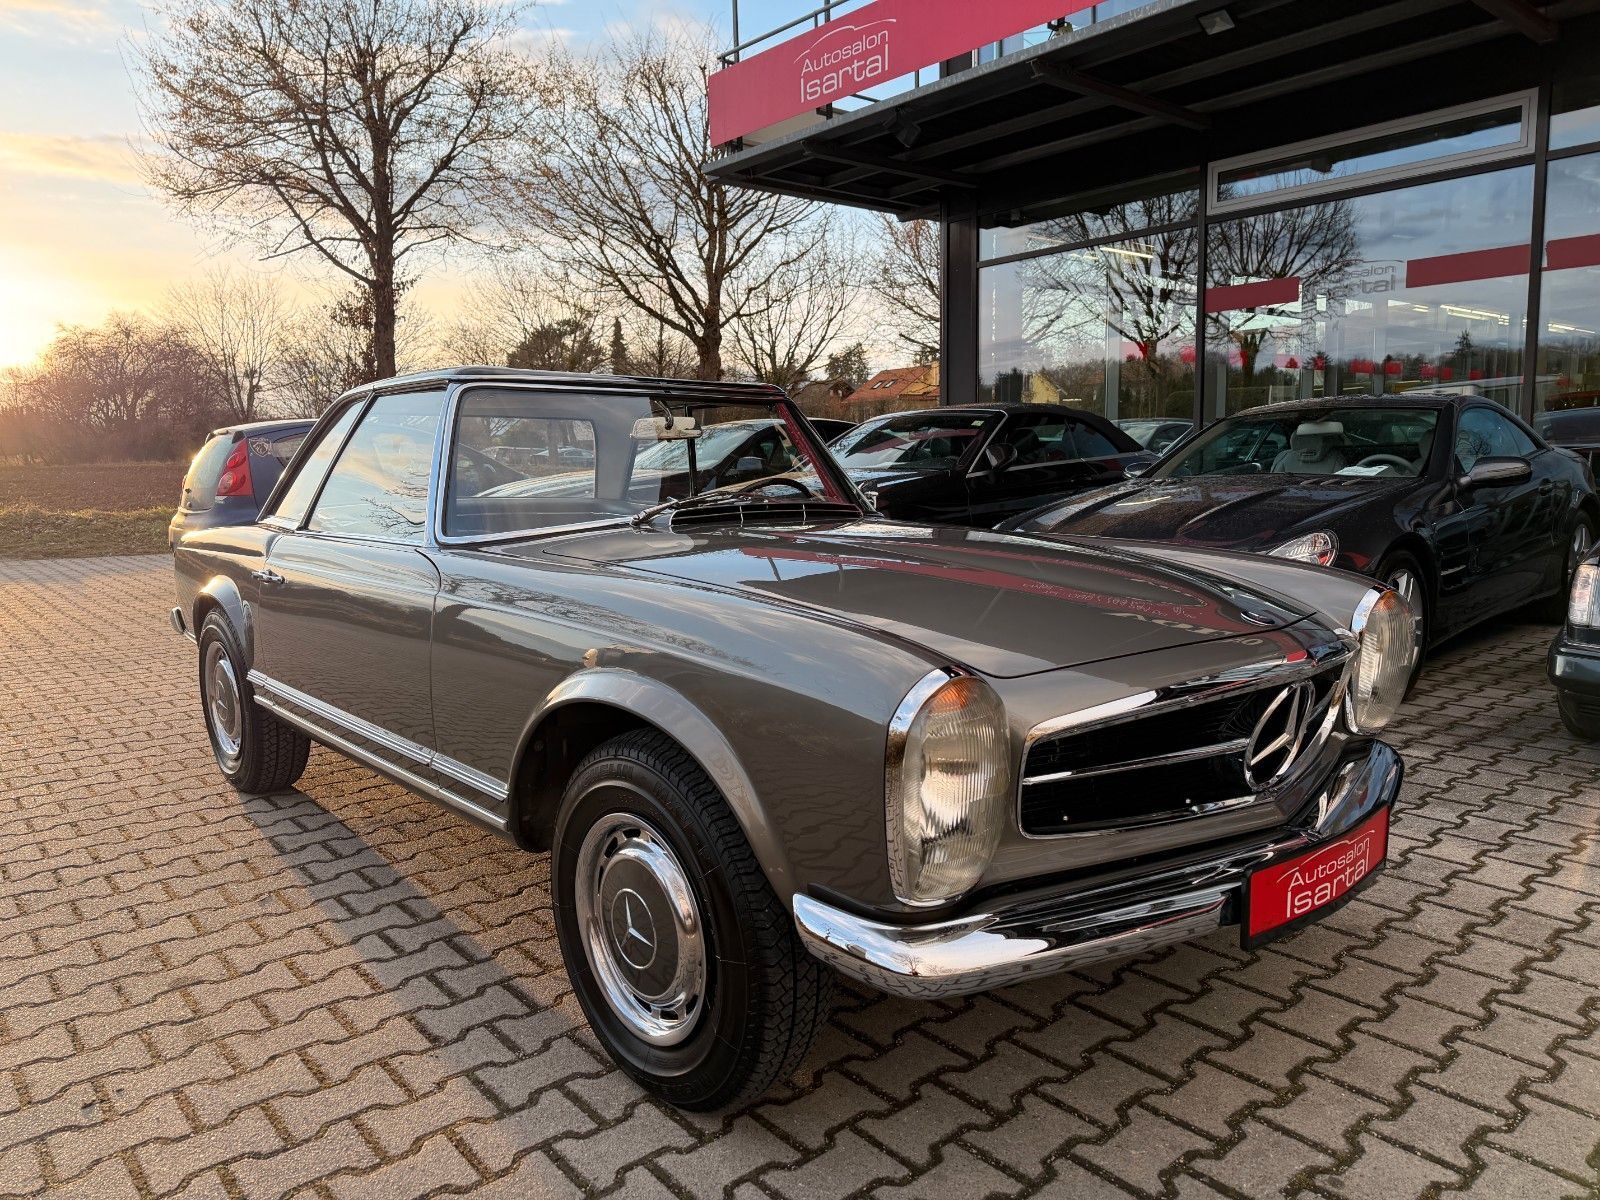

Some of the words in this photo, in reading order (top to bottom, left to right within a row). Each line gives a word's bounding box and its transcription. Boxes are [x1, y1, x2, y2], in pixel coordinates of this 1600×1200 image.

[800, 44, 889, 103] Isartal
[801, 30, 889, 77] Autosalon
[1286, 847, 1370, 918] Isartal
[1287, 837, 1370, 891] Autosalon
